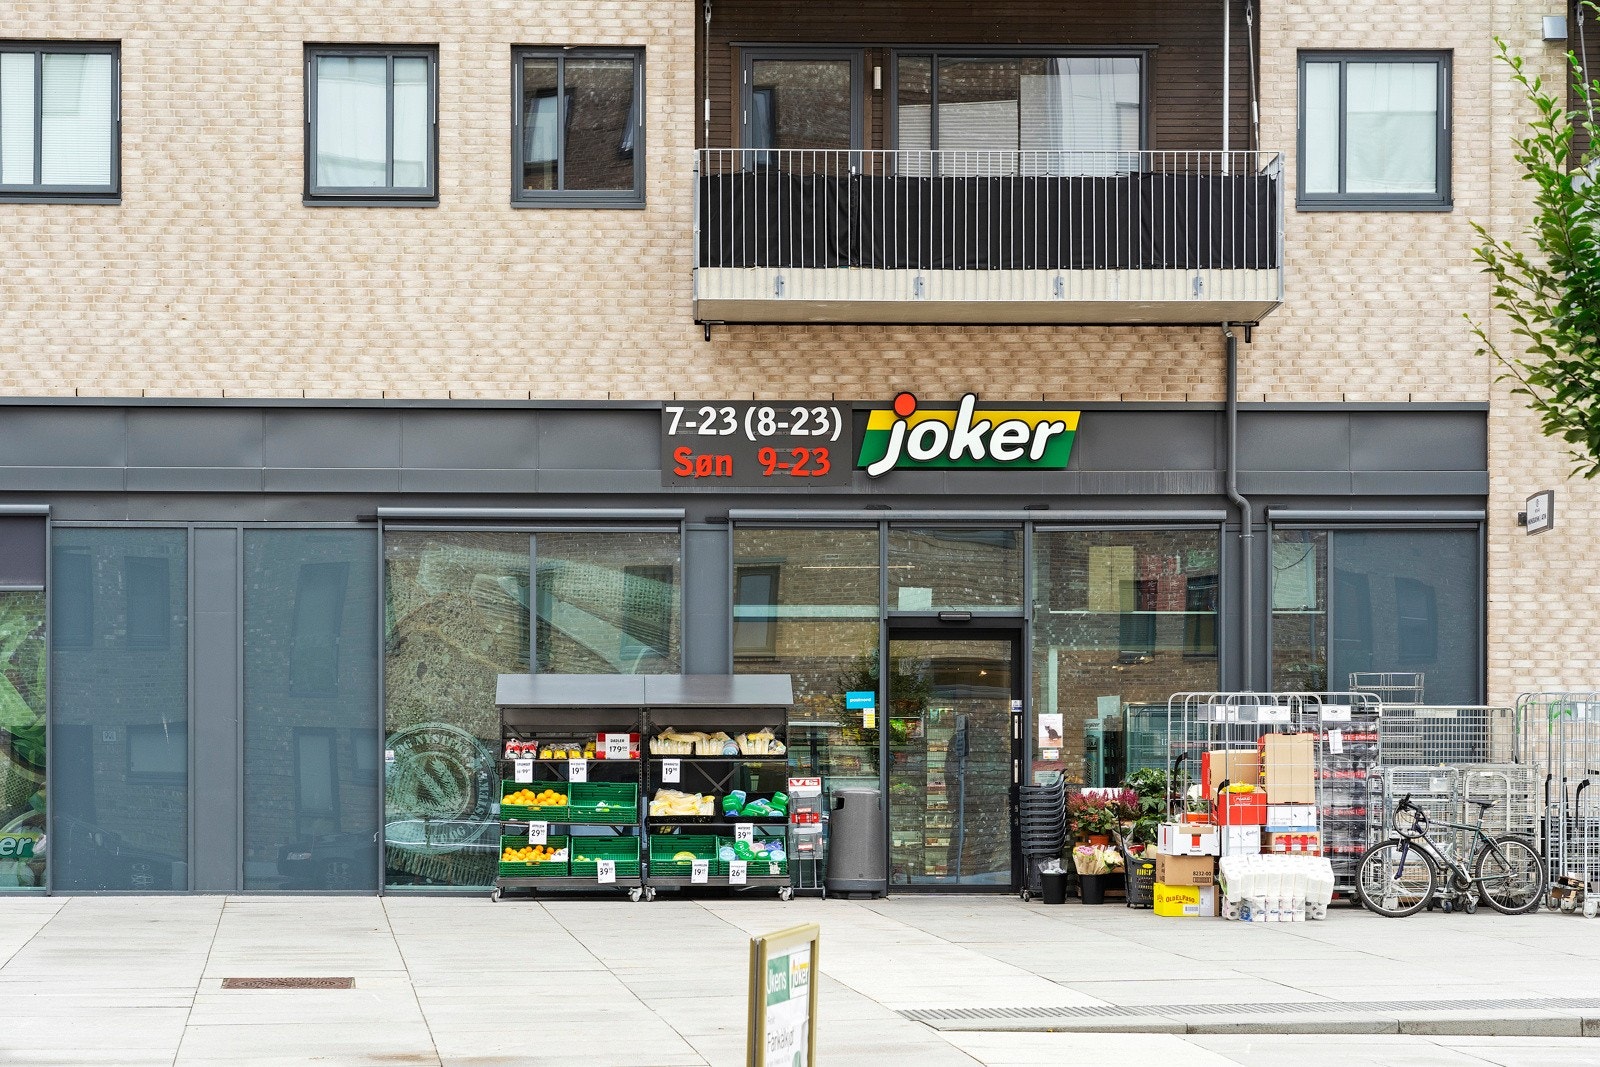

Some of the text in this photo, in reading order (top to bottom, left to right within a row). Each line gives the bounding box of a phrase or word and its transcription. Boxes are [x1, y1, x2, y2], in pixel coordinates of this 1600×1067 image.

[665, 405, 842, 442] 7-23 (8-23)
[867, 392, 1067, 477] joker
[672, 446, 831, 478] Søn 9-23
[766, 968, 787, 995] Ukens
